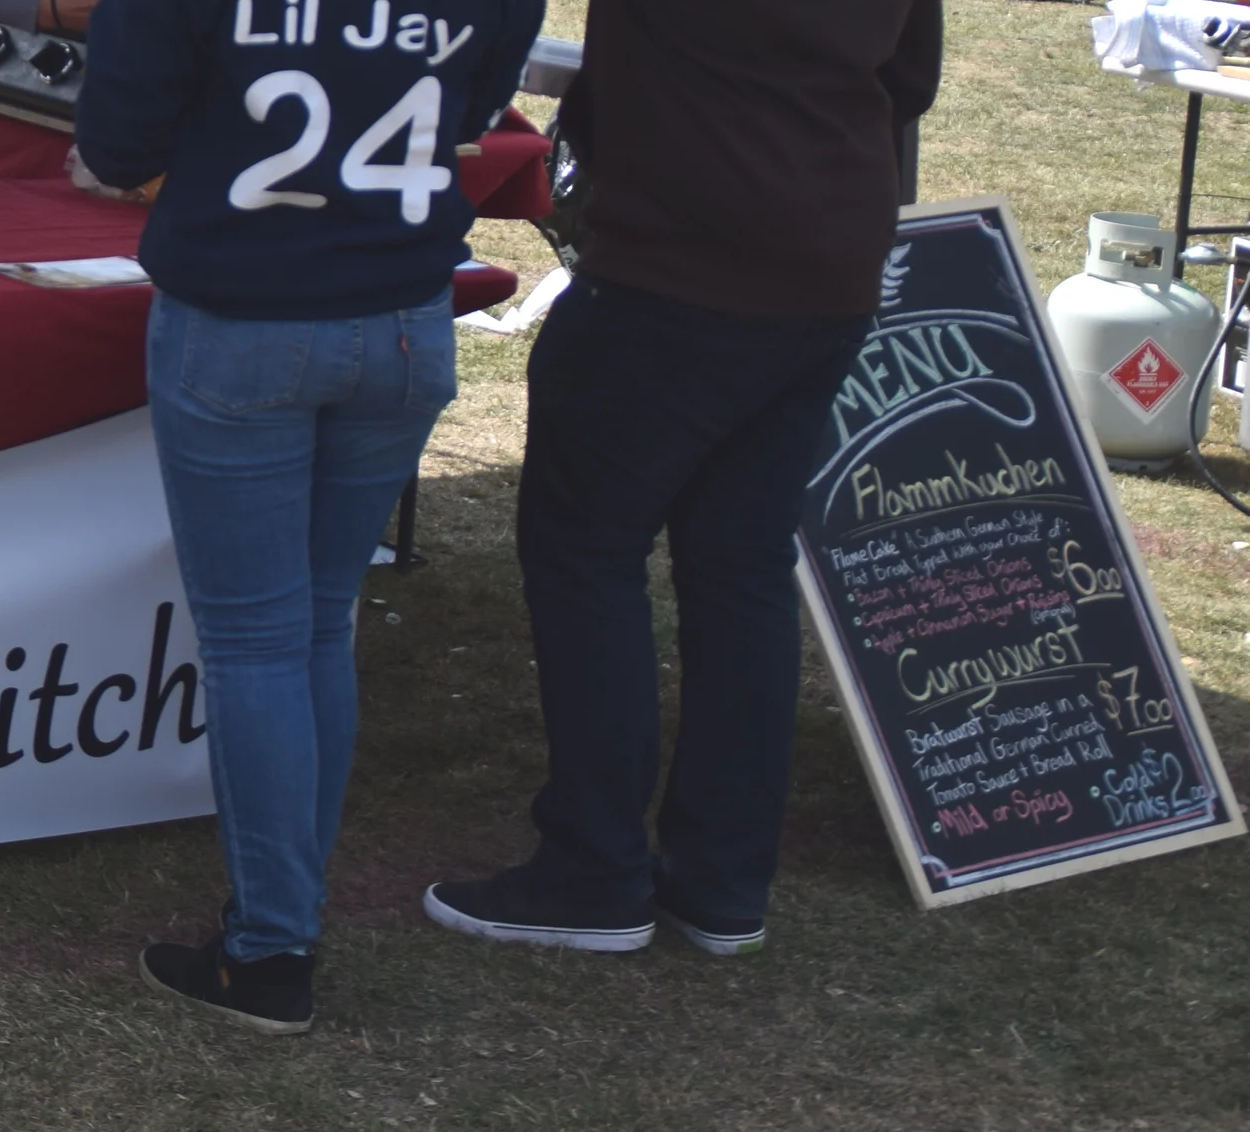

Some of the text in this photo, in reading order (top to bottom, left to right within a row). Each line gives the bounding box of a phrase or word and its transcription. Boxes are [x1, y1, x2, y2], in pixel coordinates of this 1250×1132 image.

[228, 70, 452, 225] 24
[831, 323, 994, 446] MENU
[964, 516, 1012, 537] German
[1012, 510, 1044, 533] Style
[844, 568, 869, 587] Flat
[871, 559, 915, 581] Bread
[905, 693, 1094, 754] Bratwurst Sausage in a
[912, 741, 989, 783] Traditional
[989, 733, 1051, 761] German
[926, 776, 977, 806] Tomato
[976, 770, 1021, 794] Sauce
[1029, 746, 1078, 776] Bread
[1077, 732, 1114, 762] Roll
[1103, 761, 1155, 795] Cold
[937, 788, 1074, 839] Mild or Spicy
[1102, 787, 1170, 827] Drinks
